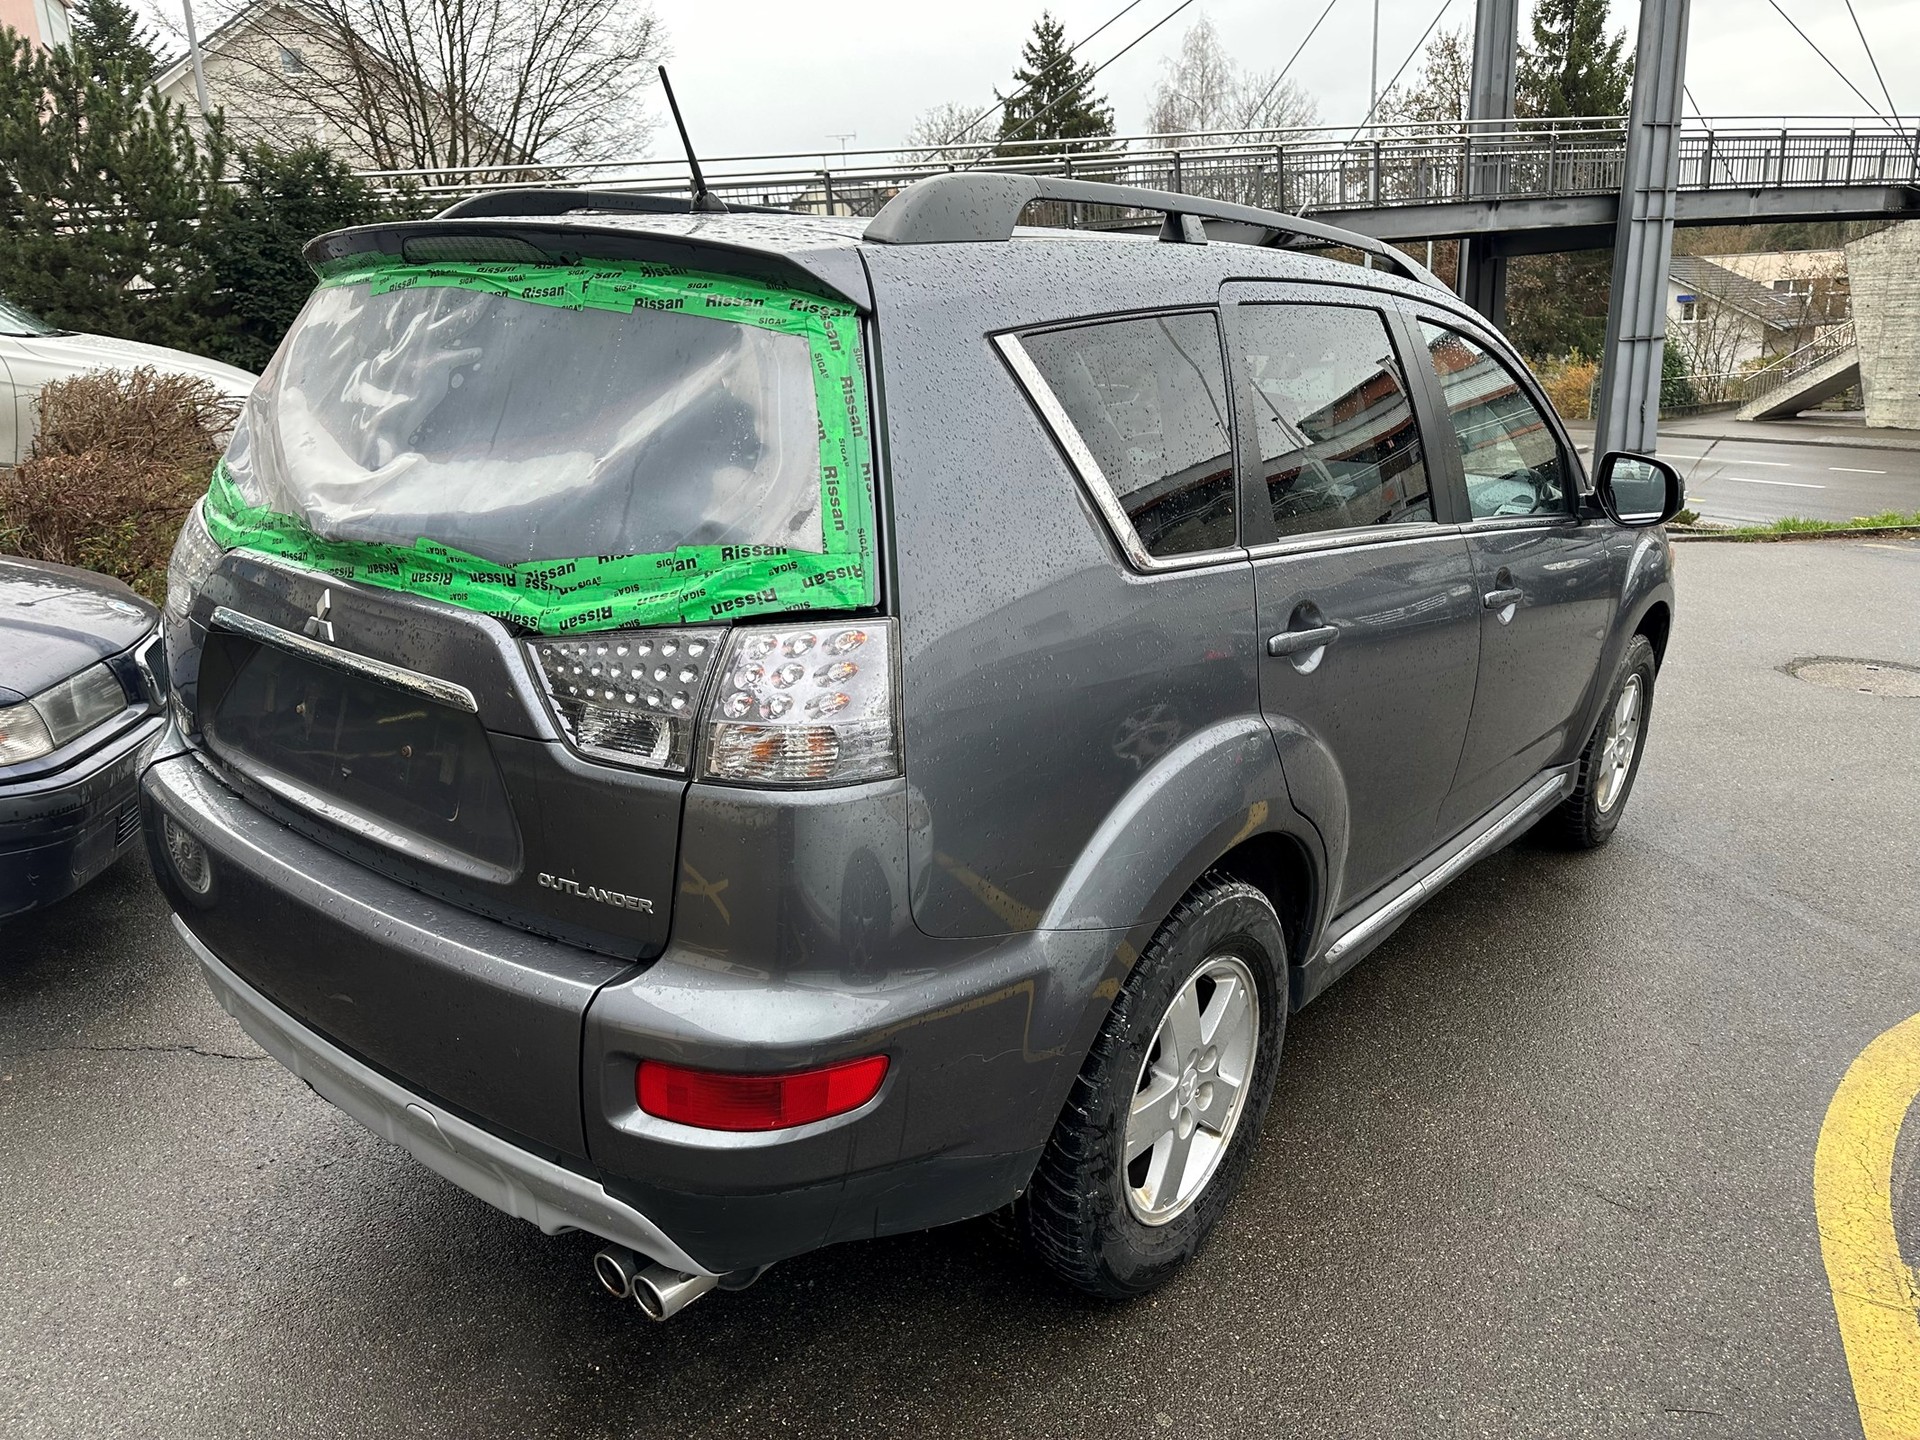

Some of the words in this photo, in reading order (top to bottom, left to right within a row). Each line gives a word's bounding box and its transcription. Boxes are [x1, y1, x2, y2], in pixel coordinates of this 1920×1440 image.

[508, 274, 524, 283] SIGA
[640, 266, 688, 278] Rissan
[459, 277, 474, 286] SIGA
[687, 282, 709, 290] SIGA
[522, 285, 565, 299] Rissan
[614, 285, 633, 293] SIGA
[634, 297, 684, 311] Rissan
[706, 294, 764, 308] Rissan
[788, 297, 856, 317] Rissan
[759, 317, 783, 326] SIGA
[814, 352, 827, 376] SIGA
[840, 375, 864, 438] Rissan
[838, 437, 848, 464] SIGA
[823, 465, 846, 532] Rissan
[857, 527, 869, 553] SIGA
[428, 546, 448, 556] SIGA
[721, 545, 788, 563] Rissan
[656, 558, 675, 569] SIG
[774, 560, 799, 576] SIGA
[411, 572, 453, 586] Rissan
[469, 572, 517, 588] Rissan
[802, 562, 863, 590] Rissan
[451, 592, 468, 601] SIGA
[616, 583, 640, 597] SIGA
[681, 588, 707, 602] SIGA
[710, 587, 778, 617] Rissan
[559, 605, 613, 631] Rissan
[537, 872, 654, 914] OUTLANDER
